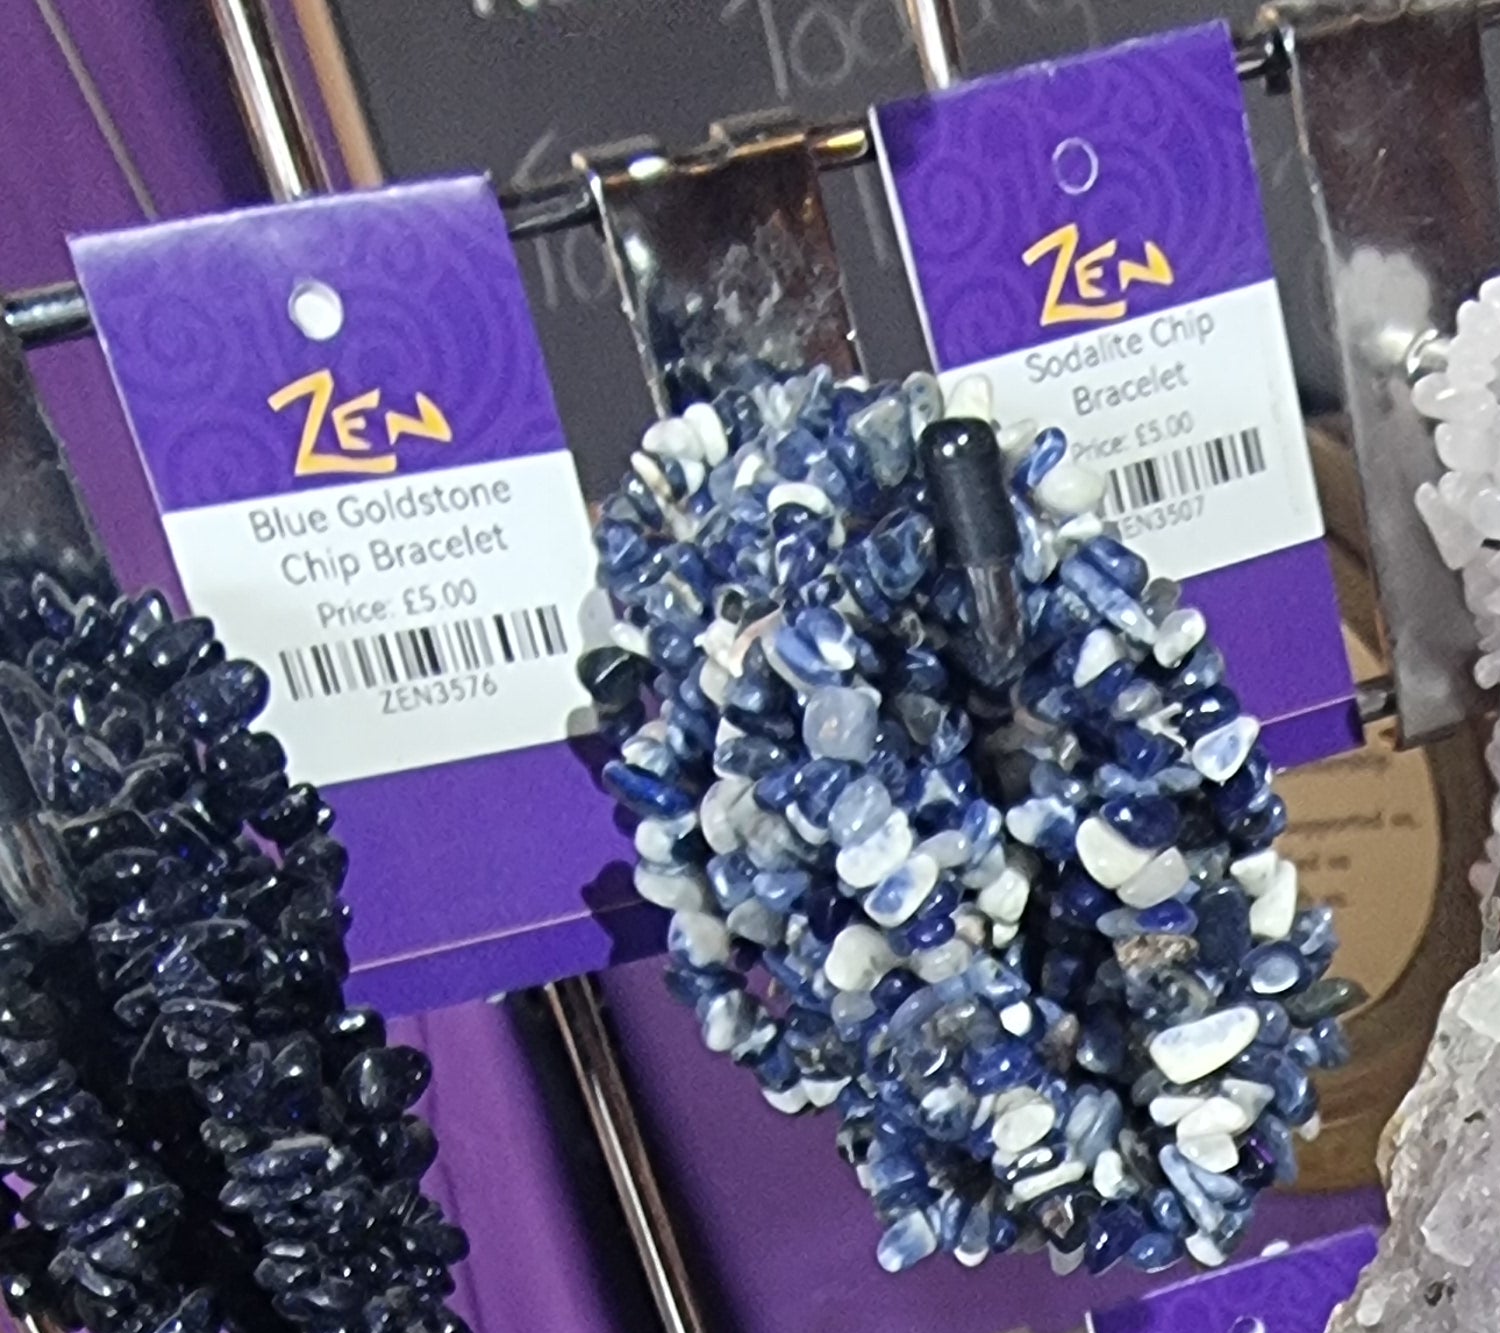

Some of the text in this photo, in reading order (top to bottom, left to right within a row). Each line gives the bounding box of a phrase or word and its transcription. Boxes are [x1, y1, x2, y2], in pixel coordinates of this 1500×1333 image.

[1022, 224, 1173, 327] ZEN
[1025, 308, 1215, 385] Sodalite Chip
[1072, 362, 1188, 417] Bracelet
[267, 370, 452, 476] ZEN
[1135, 411, 1194, 448] £5.00
[249, 476, 513, 545] Blue Goldstone
[1121, 496, 1204, 539] EN3507
[281, 523, 508, 590] Chip Bracelet
[402, 578, 477, 616] £5.00
[380, 672, 499, 716] ZEN3576
